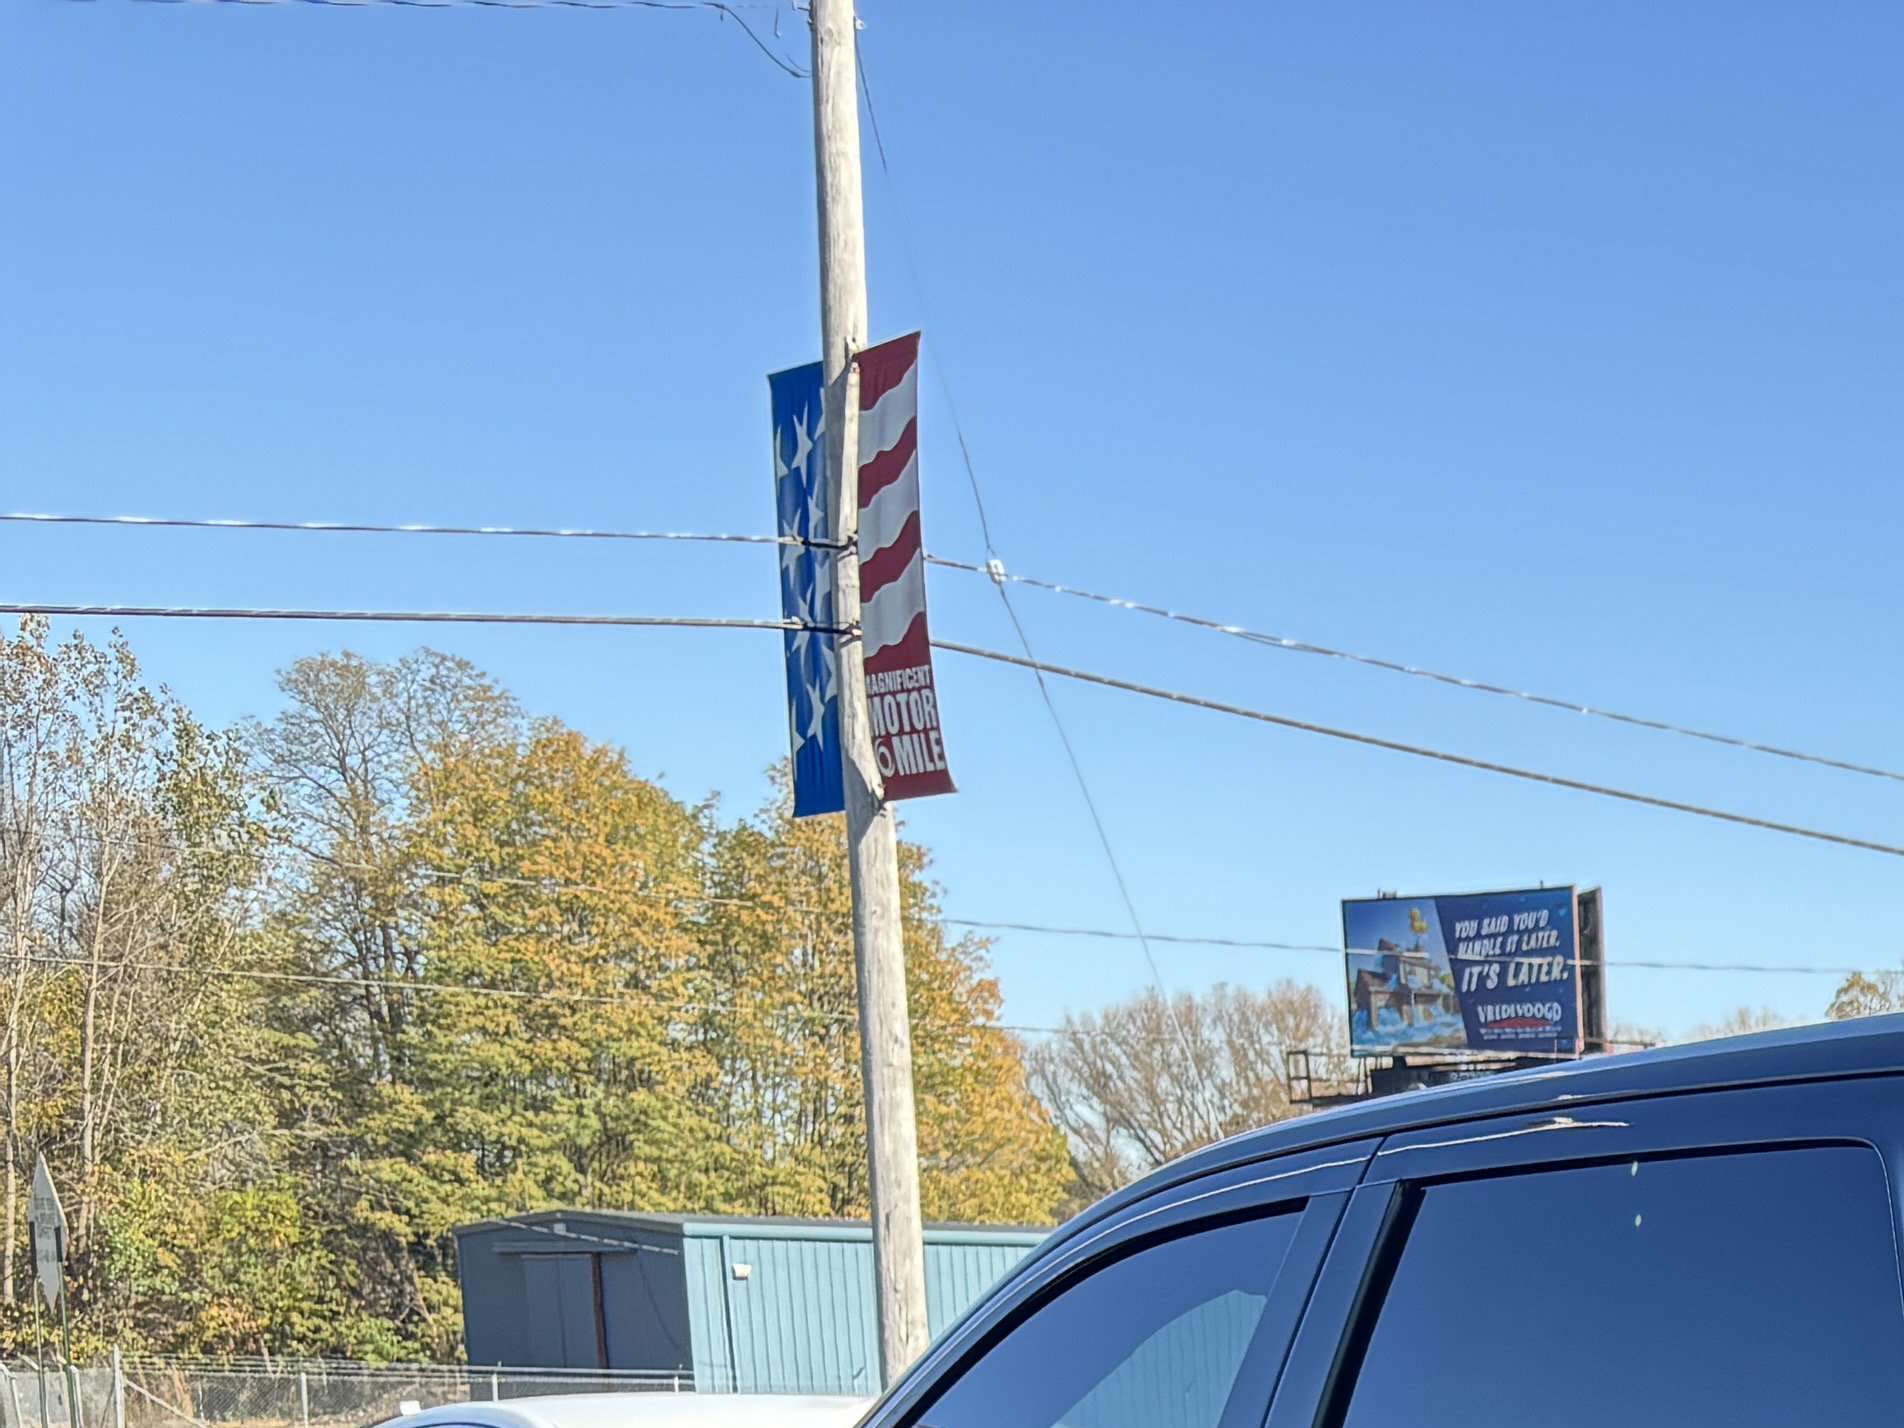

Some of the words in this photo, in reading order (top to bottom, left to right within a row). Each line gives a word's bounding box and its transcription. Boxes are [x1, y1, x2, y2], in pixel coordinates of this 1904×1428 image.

[868, 688, 937, 737] MOTOR
[892, 730, 945, 776] MILE
[1455, 920, 1478, 938] YOU
[1481, 915, 1509, 936] SAID
[1513, 909, 1549, 931] YOU'D
[1457, 936, 1504, 960] HANDLE
[1506, 934, 1519, 954] IT
[1461, 963, 1500, 993] IT'S
